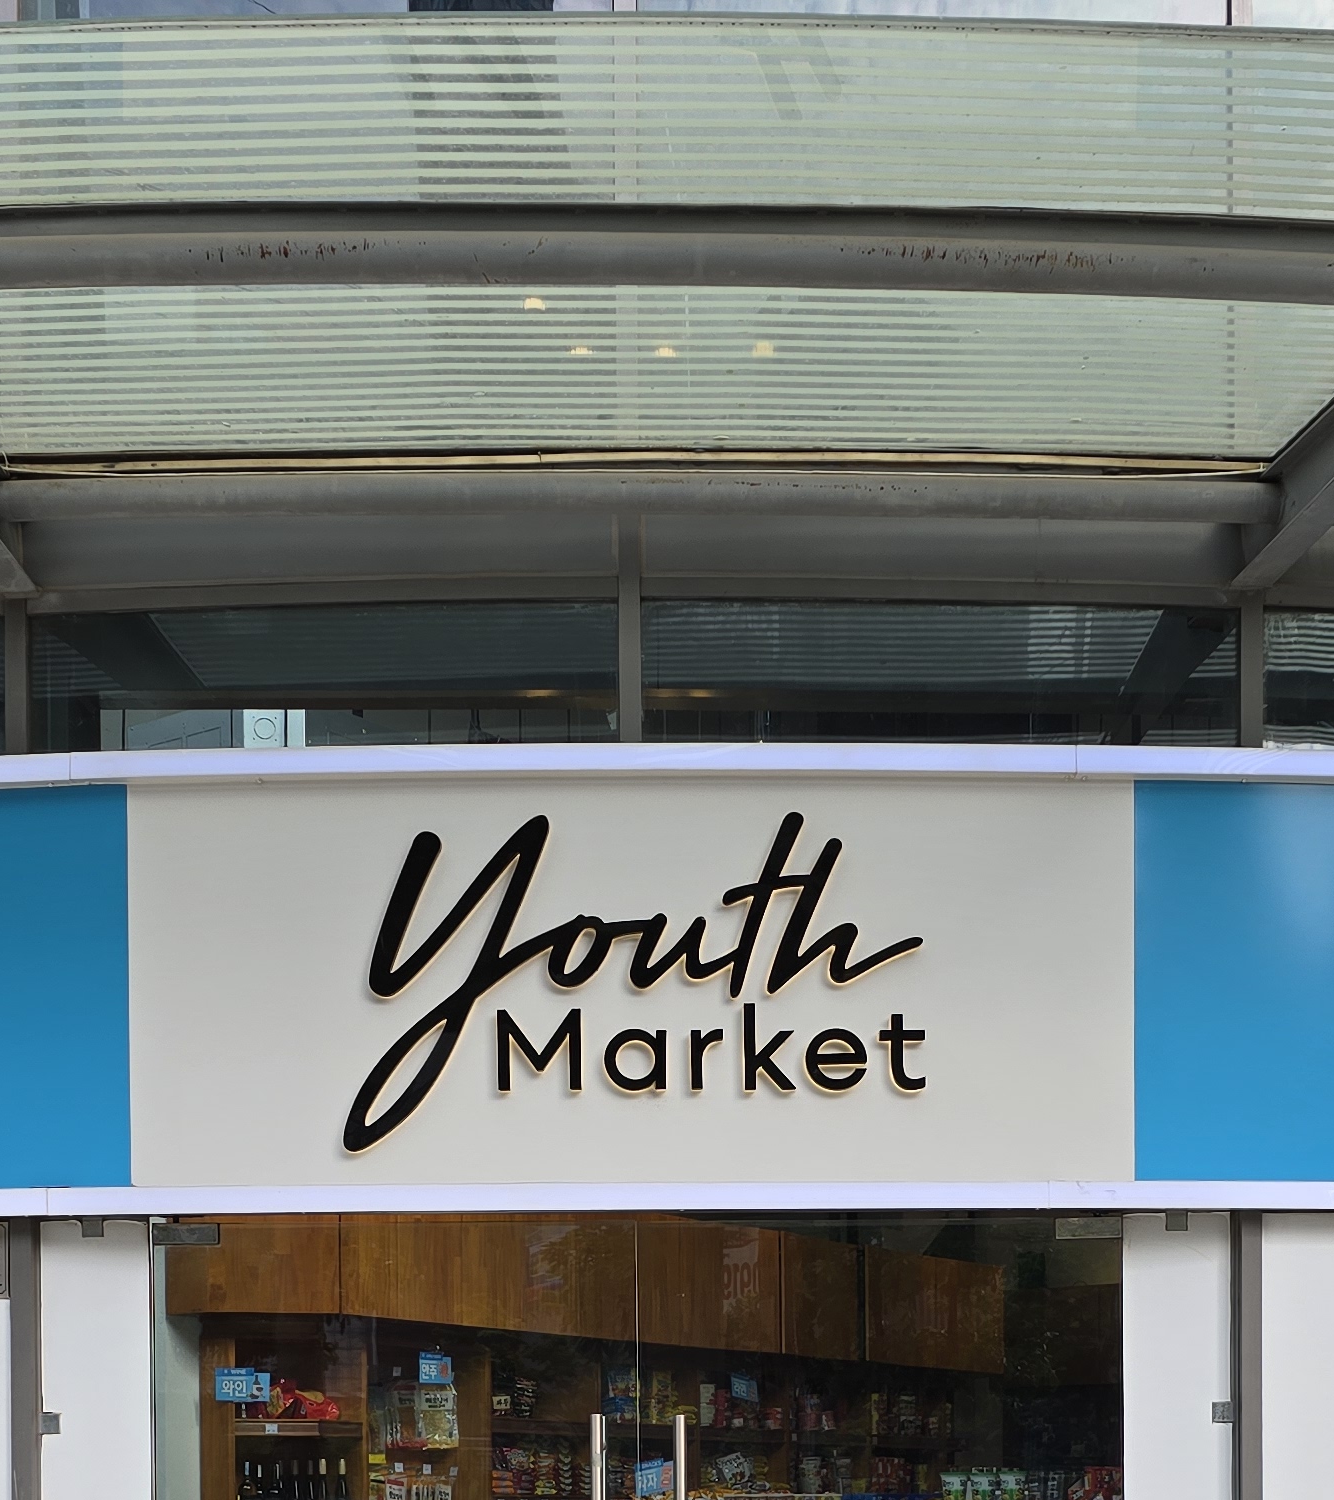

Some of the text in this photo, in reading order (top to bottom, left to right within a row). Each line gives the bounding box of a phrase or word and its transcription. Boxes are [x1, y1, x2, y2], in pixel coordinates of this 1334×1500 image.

[342, 811, 924, 1155] Youth
[495, 1002, 927, 1094] Market
[221, 1380, 248, 1398] 와인
